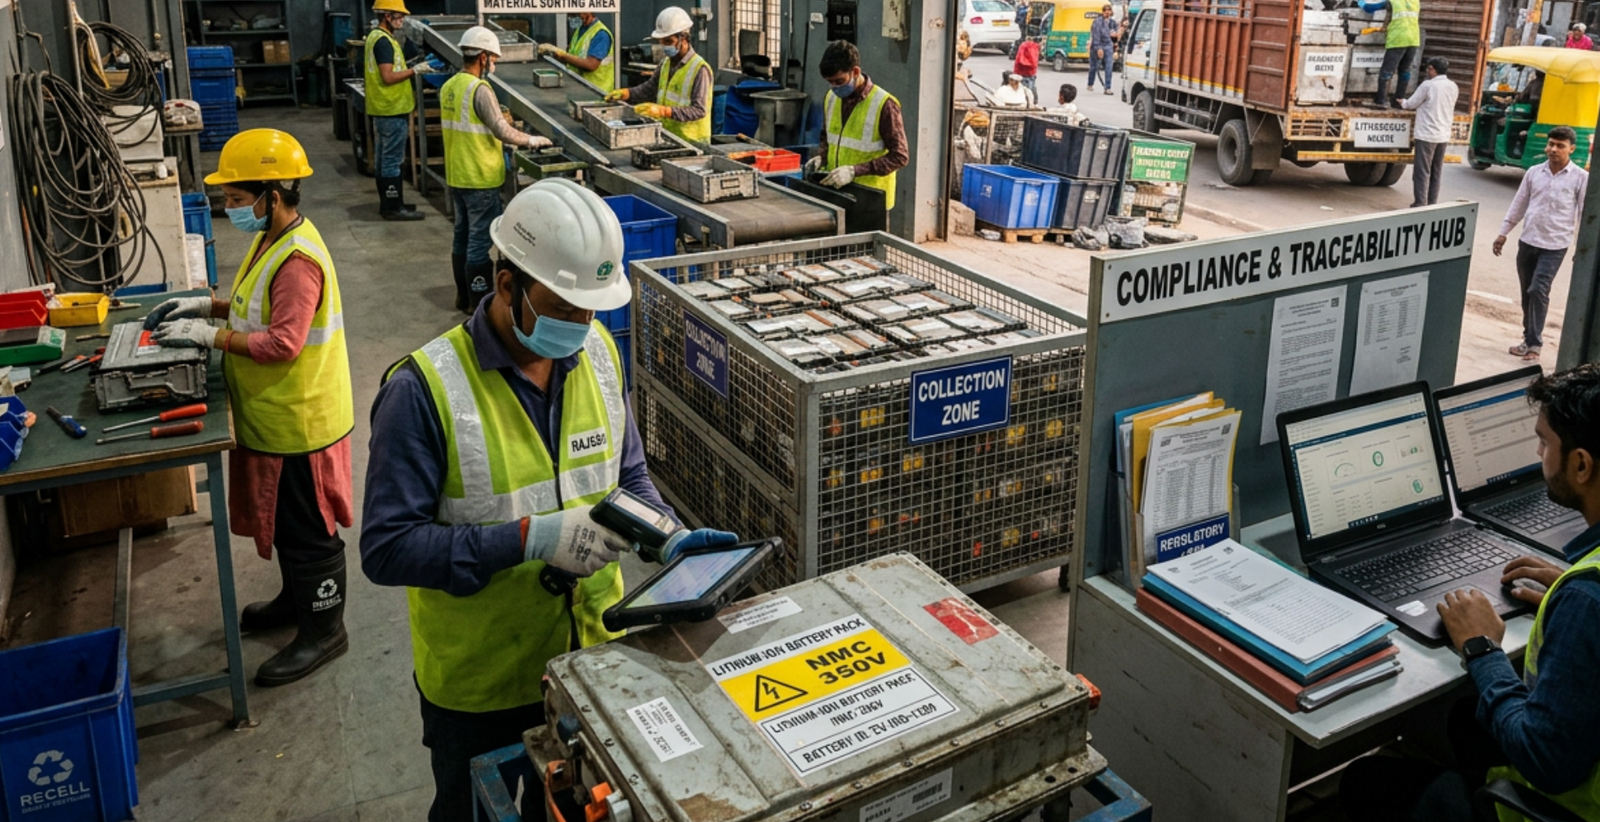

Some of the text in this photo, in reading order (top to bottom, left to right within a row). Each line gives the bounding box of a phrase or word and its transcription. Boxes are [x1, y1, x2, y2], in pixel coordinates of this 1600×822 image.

[484, 0, 616, 8] MATERIAL SORTING AREA
[1117, 216, 1467, 306] COMPLIANCE & TRACEABILITY HUB
[918, 367, 1005, 402] COLLECTION
[941, 400, 980, 426] ZONE
[805, 640, 872, 671] NMC
[818, 652, 887, 685] 350V
[20, 781, 91, 807] RECELL
